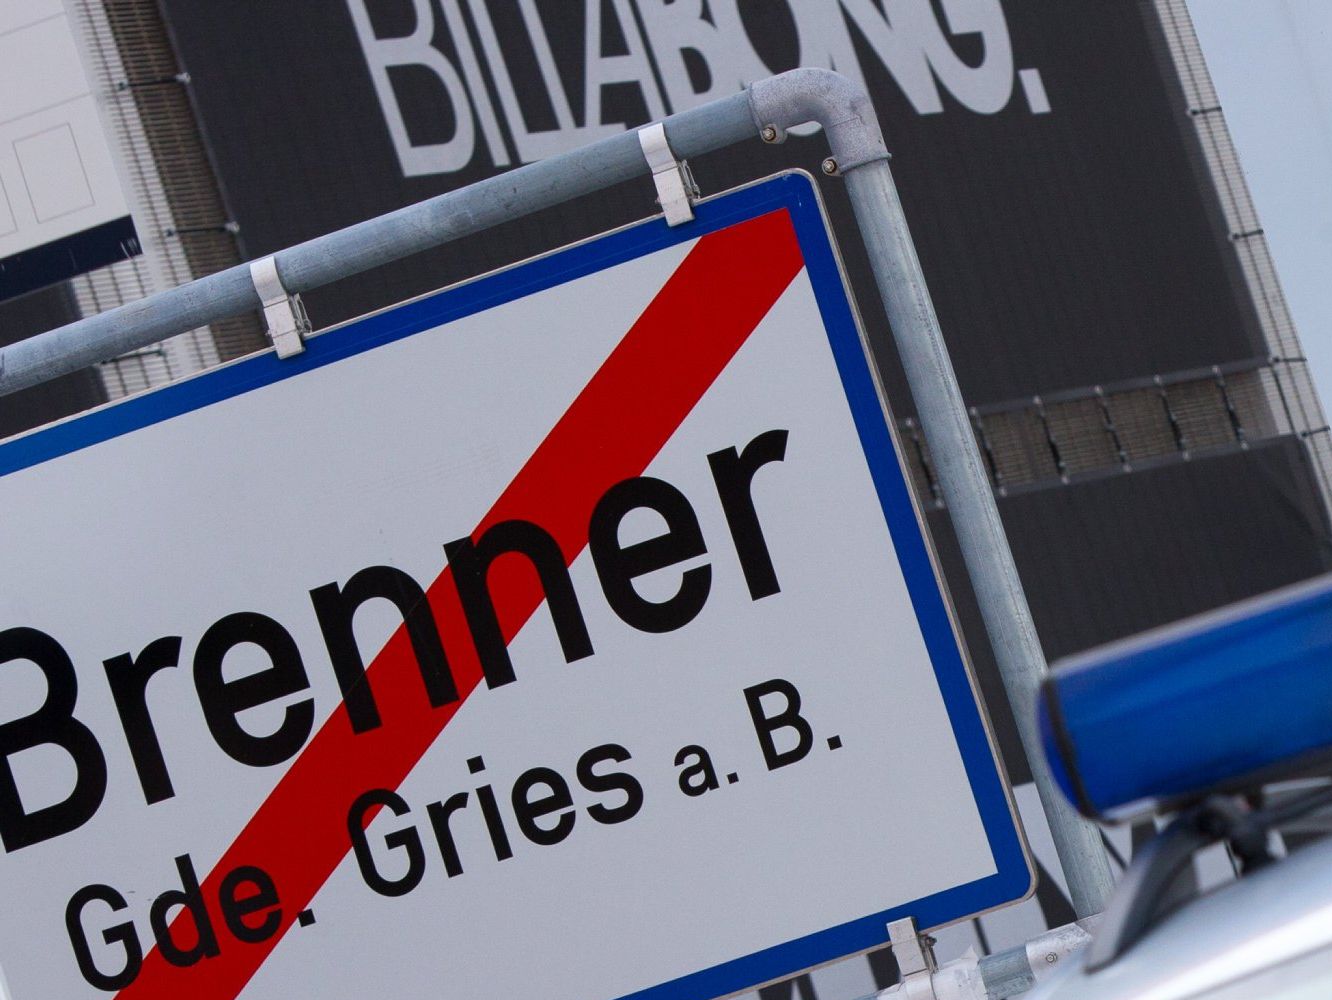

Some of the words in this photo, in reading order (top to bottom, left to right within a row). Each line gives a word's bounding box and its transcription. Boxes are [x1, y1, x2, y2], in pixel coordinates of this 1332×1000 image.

[0, 429, 790, 853] Brenner
[65, 854, 317, 993] Gde.
[346, 742, 645, 898] Gries
[672, 744, 739, 797] a.
[743, 678, 843, 772] B.
